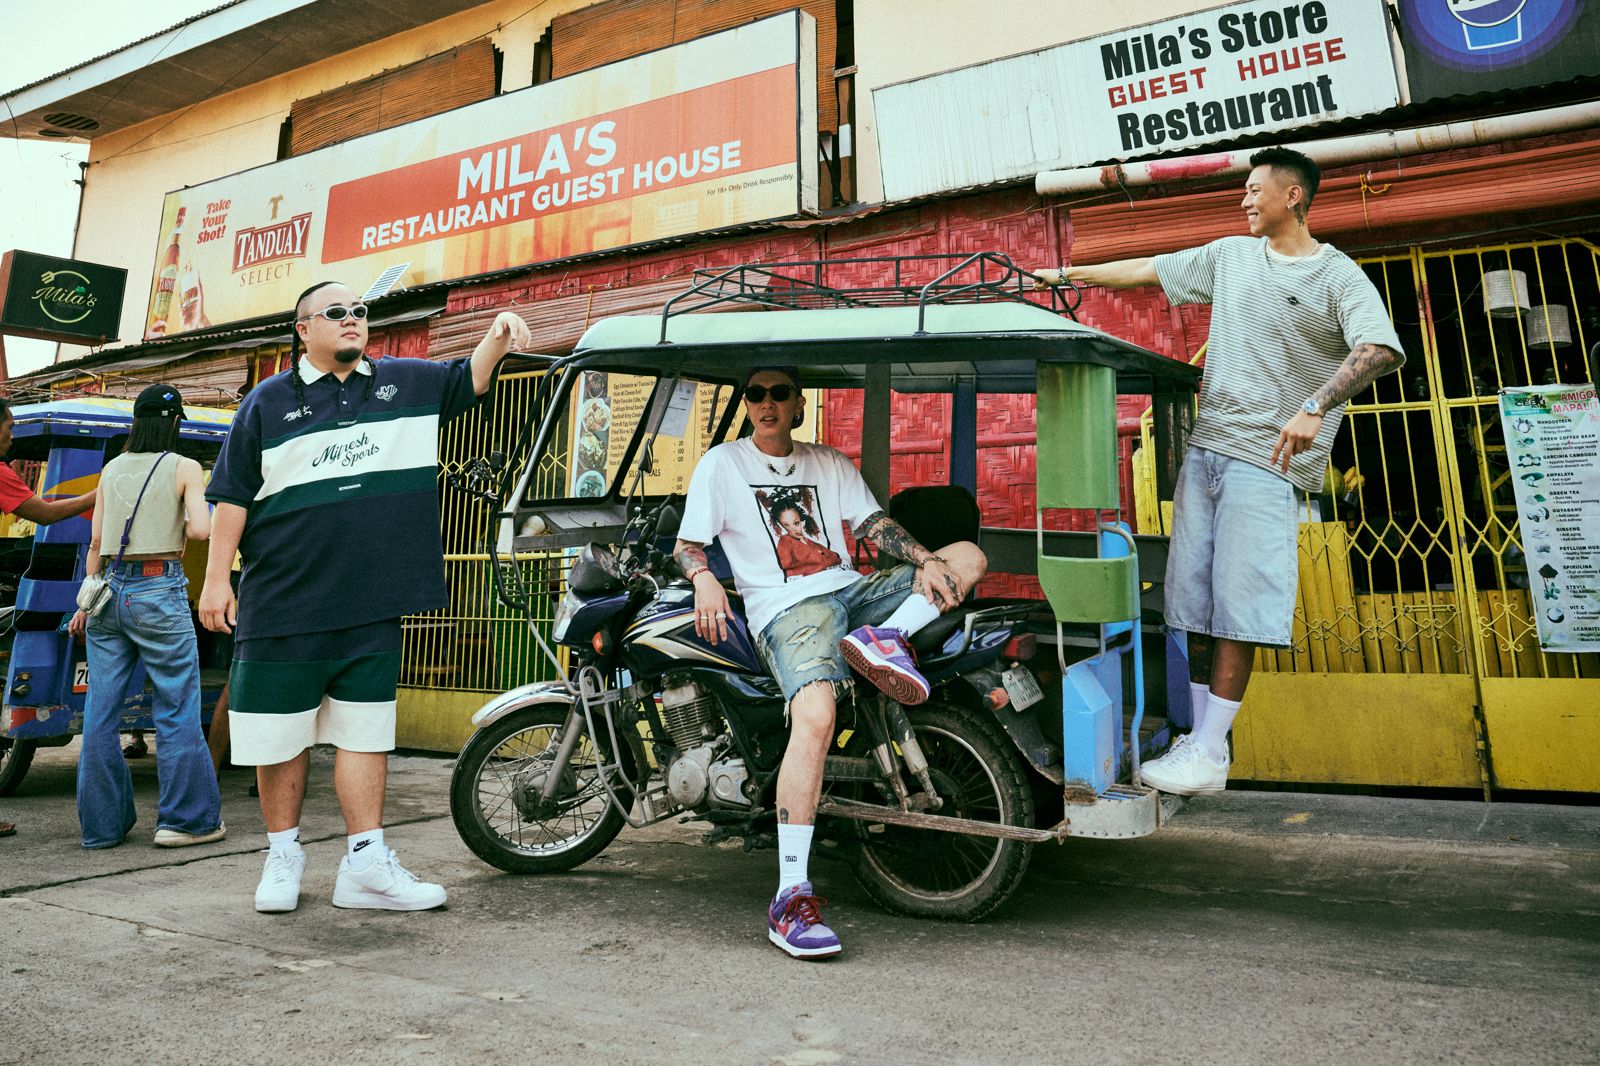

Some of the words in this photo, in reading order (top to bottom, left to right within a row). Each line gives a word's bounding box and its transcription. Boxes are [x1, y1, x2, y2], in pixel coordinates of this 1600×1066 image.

[1100, 26, 1211, 81] Mila's
[1218, 1, 1328, 53] Store
[1108, 67, 1207, 108] GUEST
[1238, 38, 1346, 81] HOUSE
[1118, 74, 1338, 151] Restaurant
[457, 120, 616, 199] MILA'S
[743, 179, 758, 188] Drink
[207, 199, 231, 214] Take
[362, 191, 526, 250] RESTAURANT
[532, 168, 624, 211] GUEST
[634, 140, 741, 189] HOUSE
[236, 217, 310, 269] TANDUAY
[32, 286, 97, 307] Mila's
[240, 262, 293, 287] SELECT
[342, 444, 380, 467] Sports
